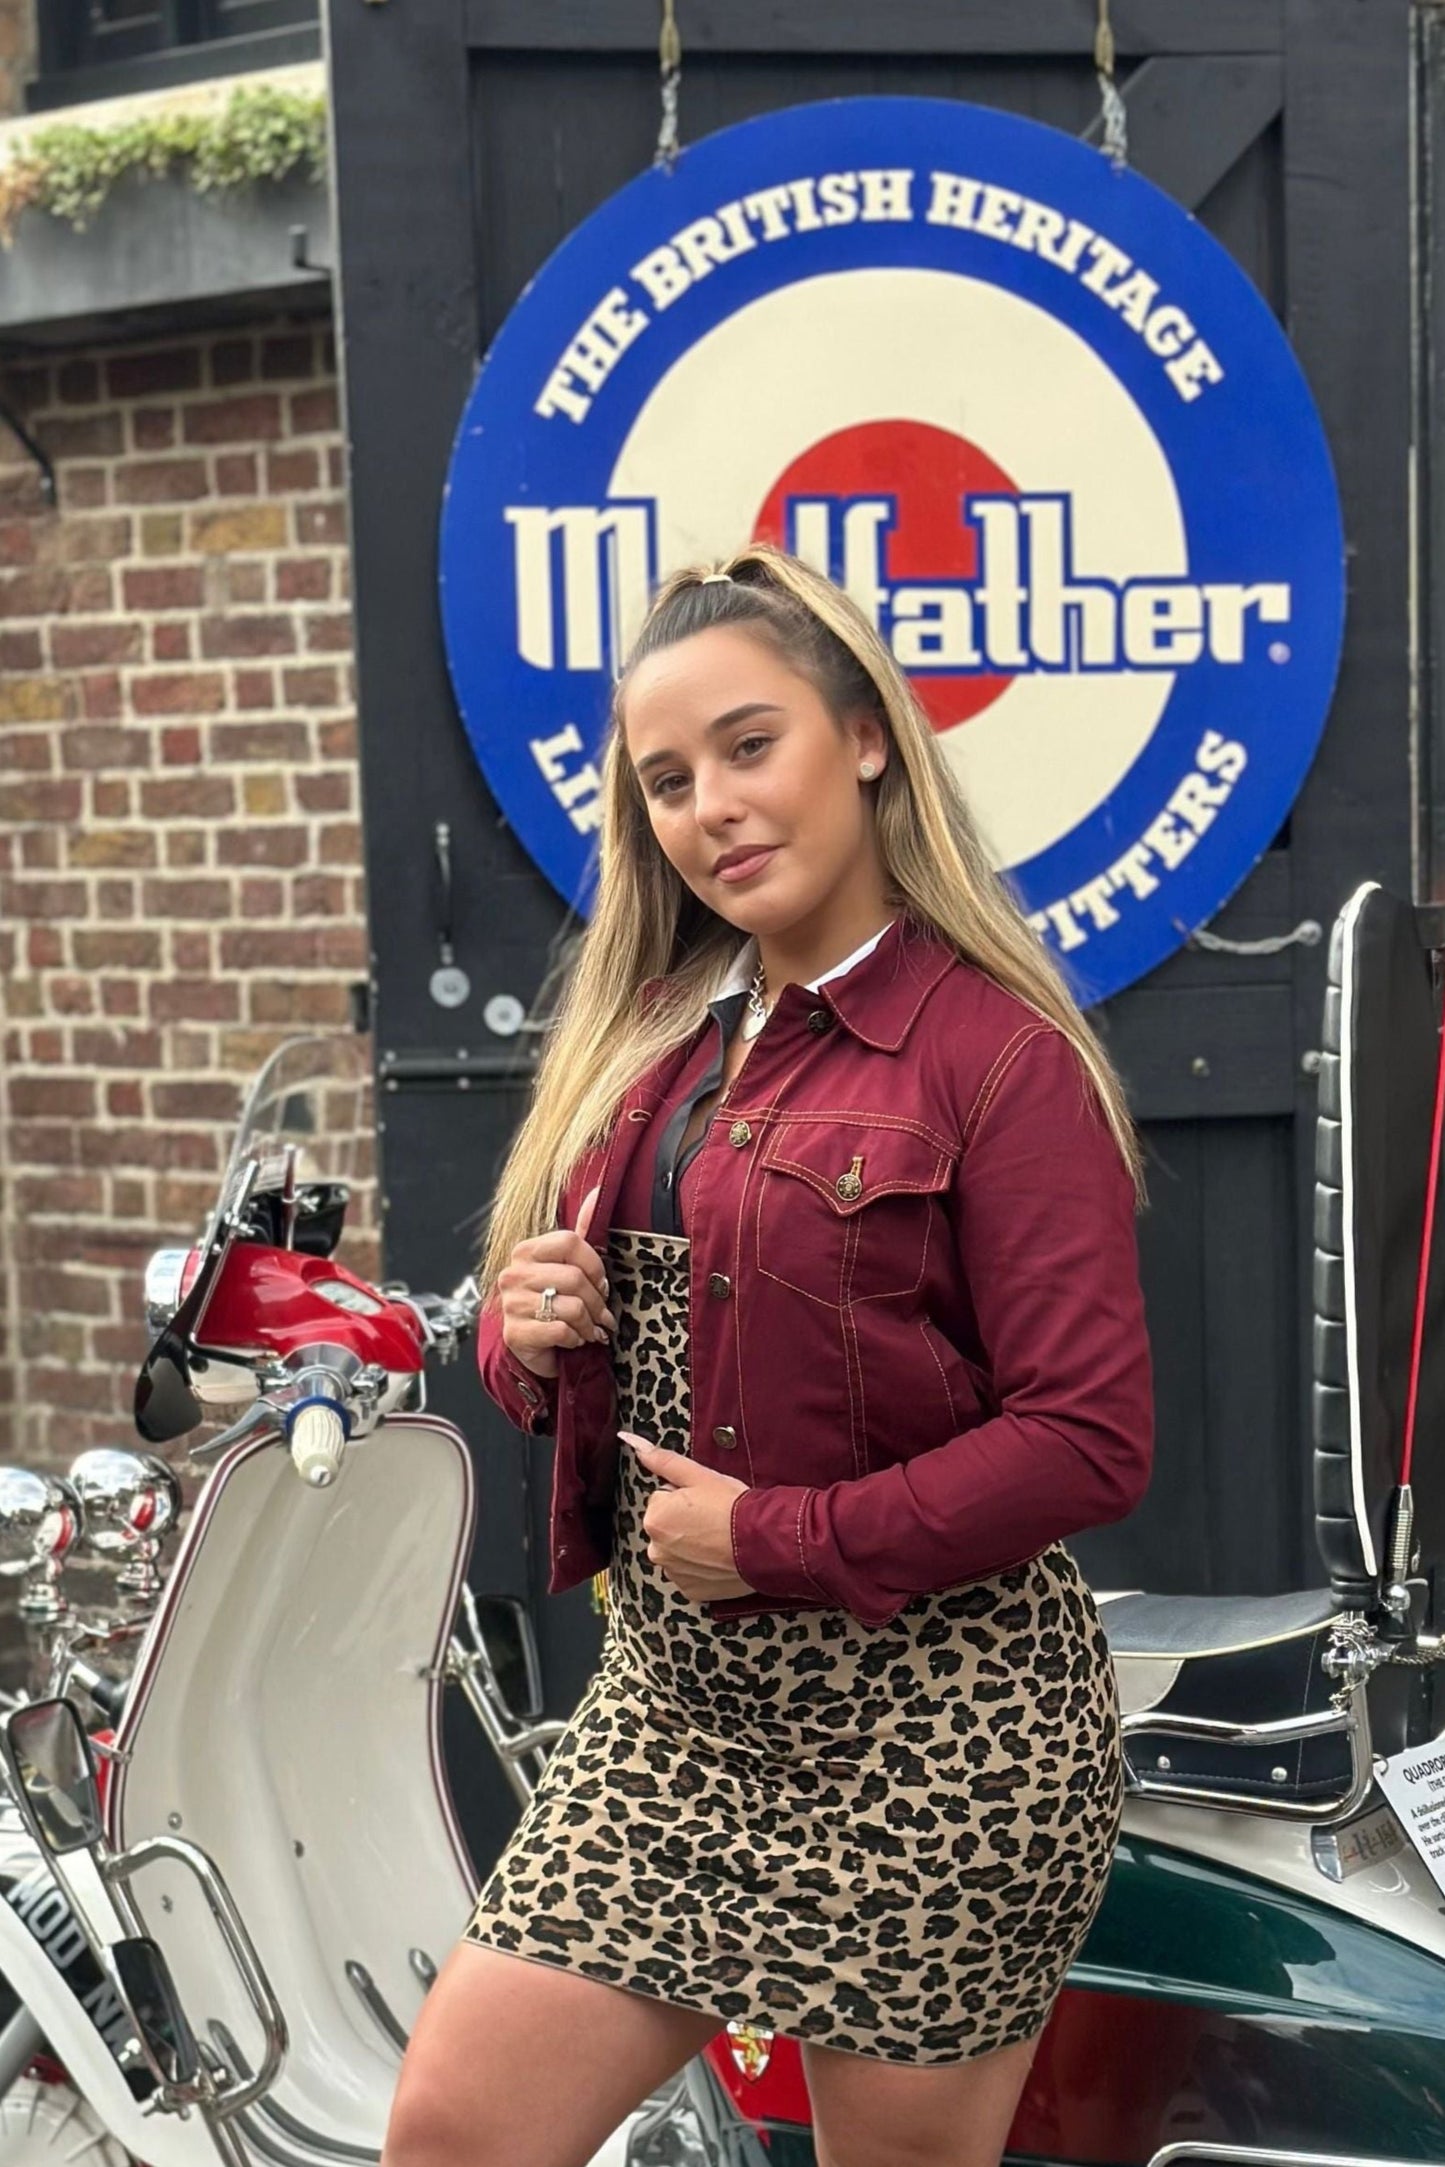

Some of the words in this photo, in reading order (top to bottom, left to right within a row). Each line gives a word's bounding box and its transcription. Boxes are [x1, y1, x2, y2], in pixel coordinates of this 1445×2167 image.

[534, 286, 650, 425] THE
[629, 169, 914, 312] BRITISH
[926, 171, 1225, 402] HERITAGE
[503, 499, 1290, 671] Mfather
[6, 1866, 88, 1969] MOD
